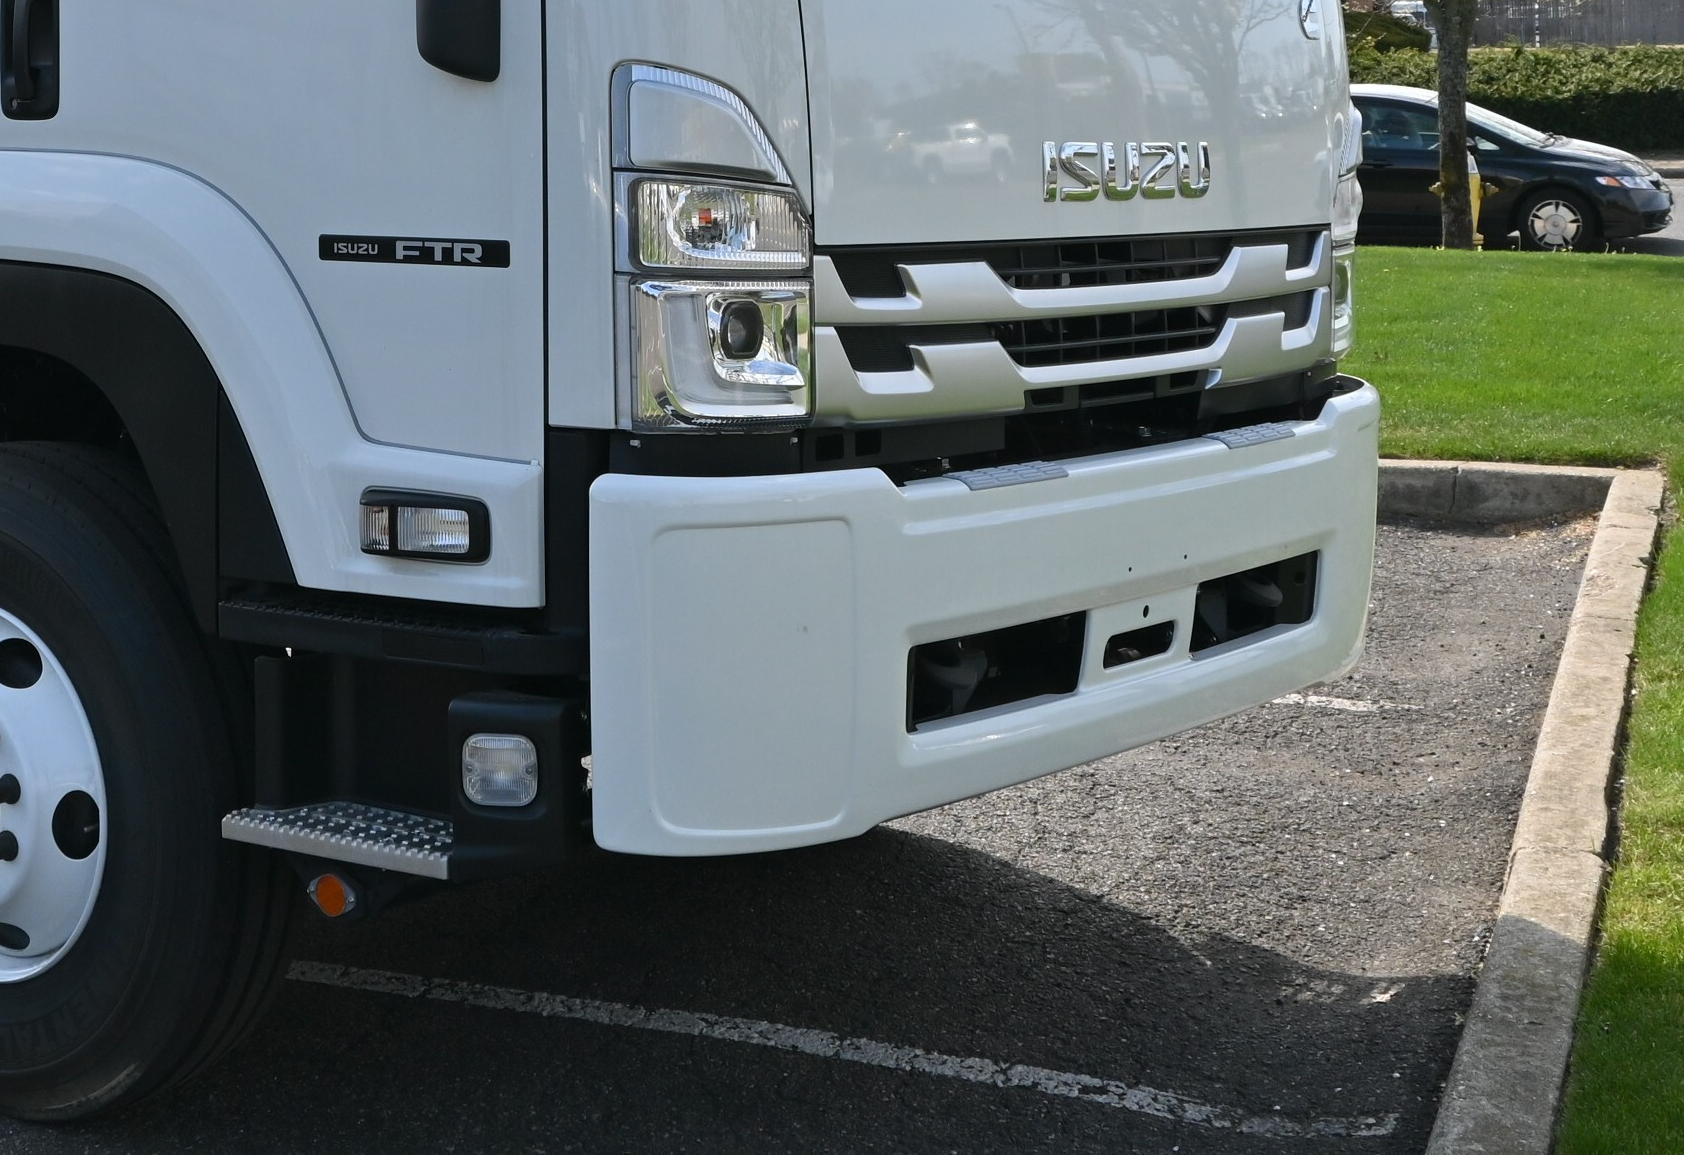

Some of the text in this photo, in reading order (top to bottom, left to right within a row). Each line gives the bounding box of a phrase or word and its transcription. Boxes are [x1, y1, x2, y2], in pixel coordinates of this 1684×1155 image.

[1042, 141, 1211, 202] ISUZU
[333, 240, 483, 264] ISUZU FTR
